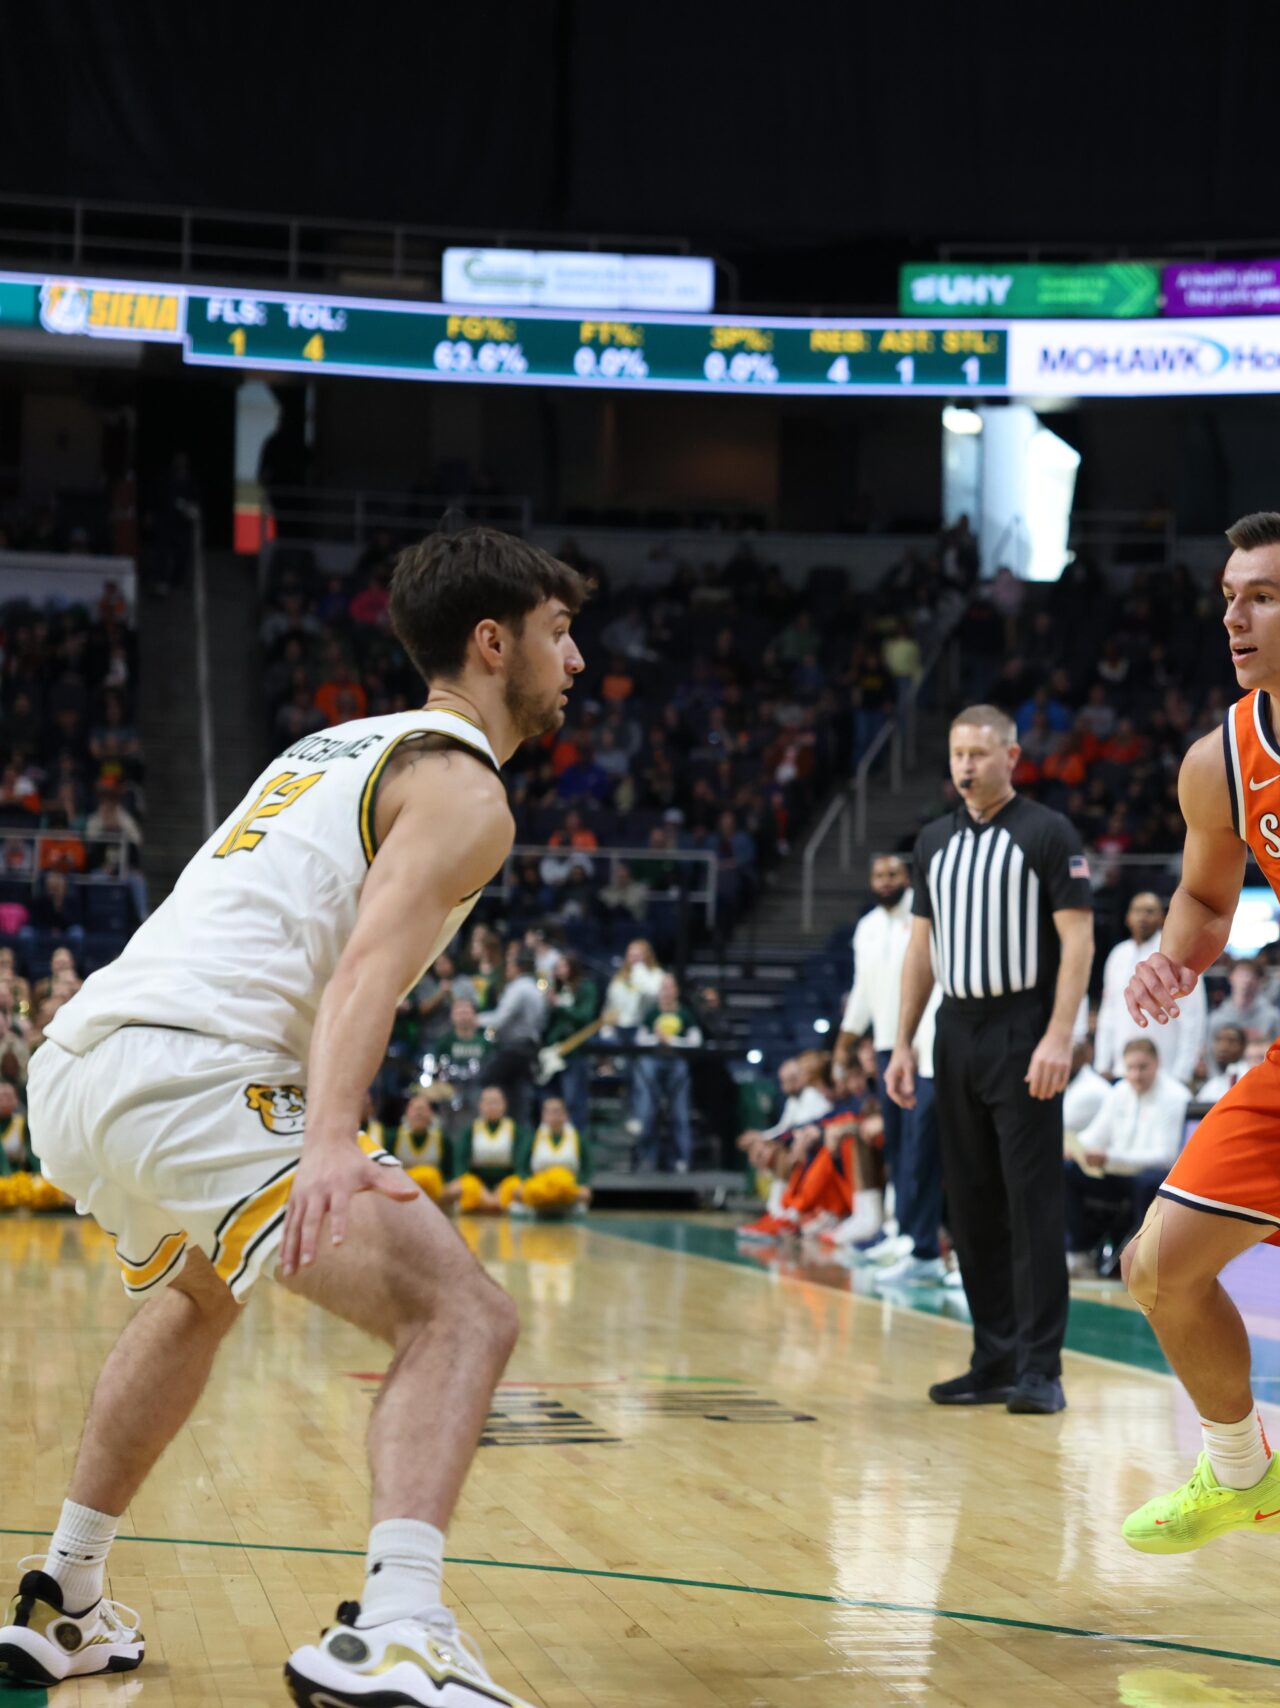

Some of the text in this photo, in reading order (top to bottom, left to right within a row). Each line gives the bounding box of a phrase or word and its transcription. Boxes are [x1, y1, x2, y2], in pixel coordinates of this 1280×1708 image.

[88, 289, 180, 331] SIENA
[227, 327, 325, 362] 1 4
[1038, 345, 1199, 376] MOHAWK
[827, 355, 850, 384] 4
[896, 355, 915, 385] 1
[961, 355, 980, 385] 1
[211, 769, 328, 860] 12
